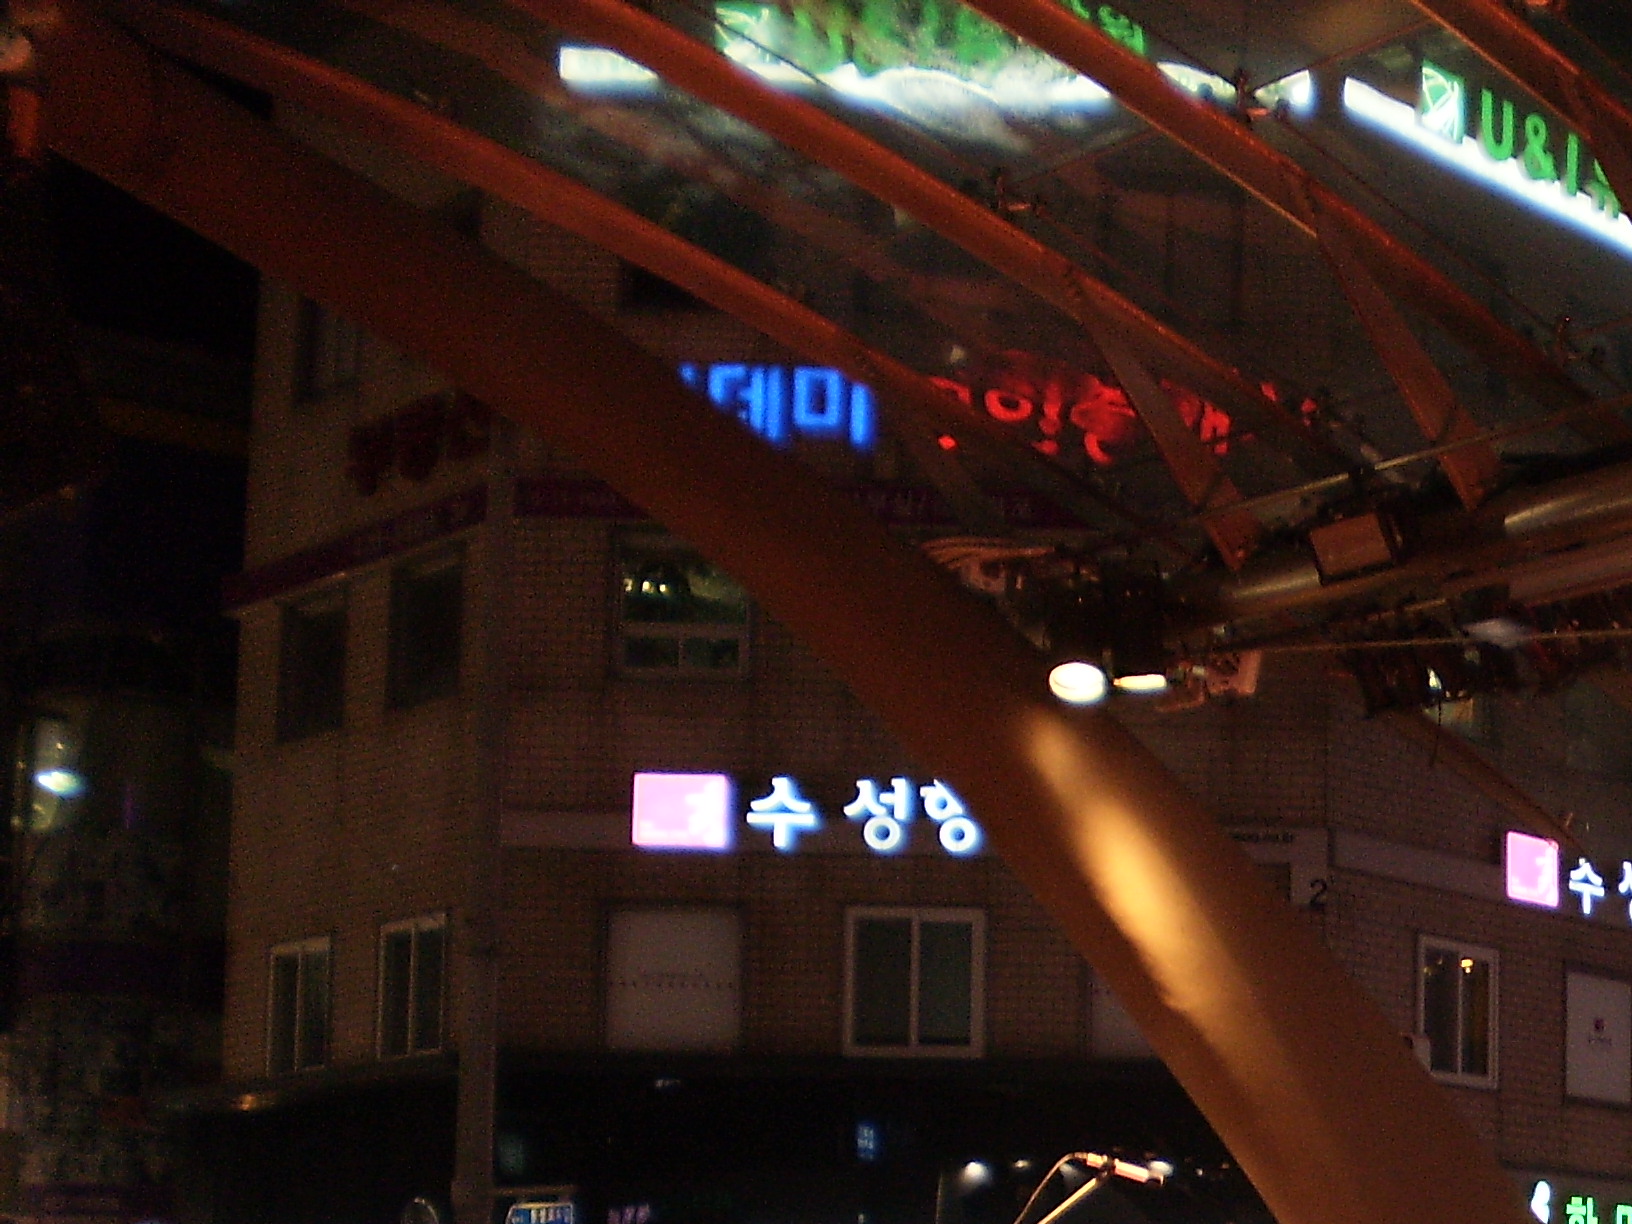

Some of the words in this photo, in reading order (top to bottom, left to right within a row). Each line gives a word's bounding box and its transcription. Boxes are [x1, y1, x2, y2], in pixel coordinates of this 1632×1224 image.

[680, 362, 875, 448] 데미
[746, 776, 817, 849] 수
[843, 778, 979, 853] 성형
[1568, 857, 1605, 916] 수
